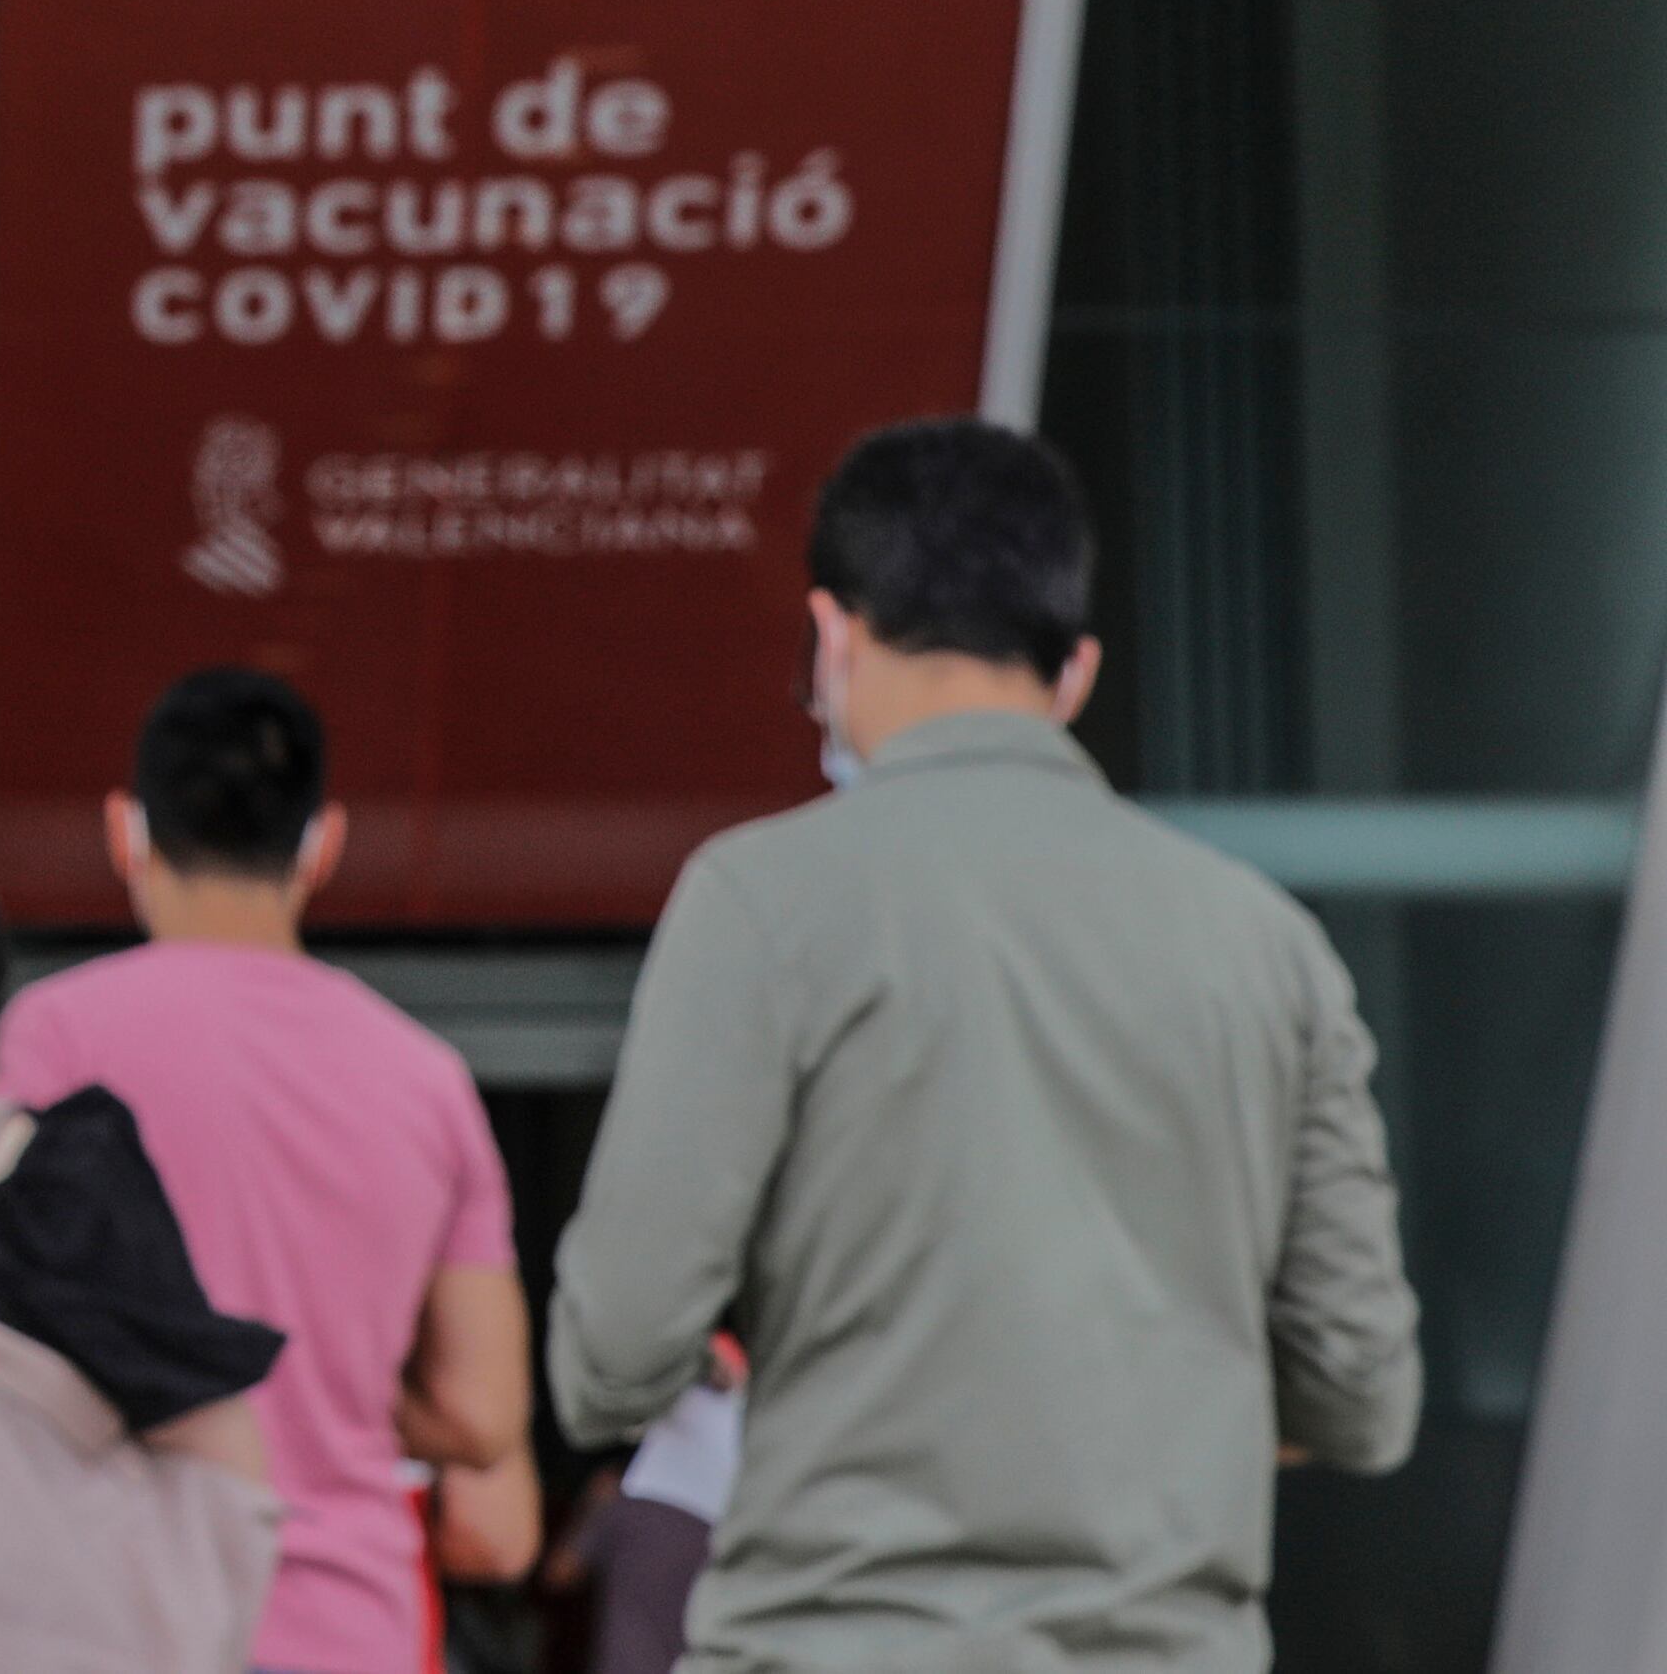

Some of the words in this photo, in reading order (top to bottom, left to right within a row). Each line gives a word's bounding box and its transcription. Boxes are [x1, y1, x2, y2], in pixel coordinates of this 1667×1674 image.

[133, 66, 457, 176] punt
[491, 58, 671, 158] de
[135, 148, 854, 254] vacunació
[304, 451, 770, 504] GENERALITAT
[311, 508, 756, 555] VALENCIANA
